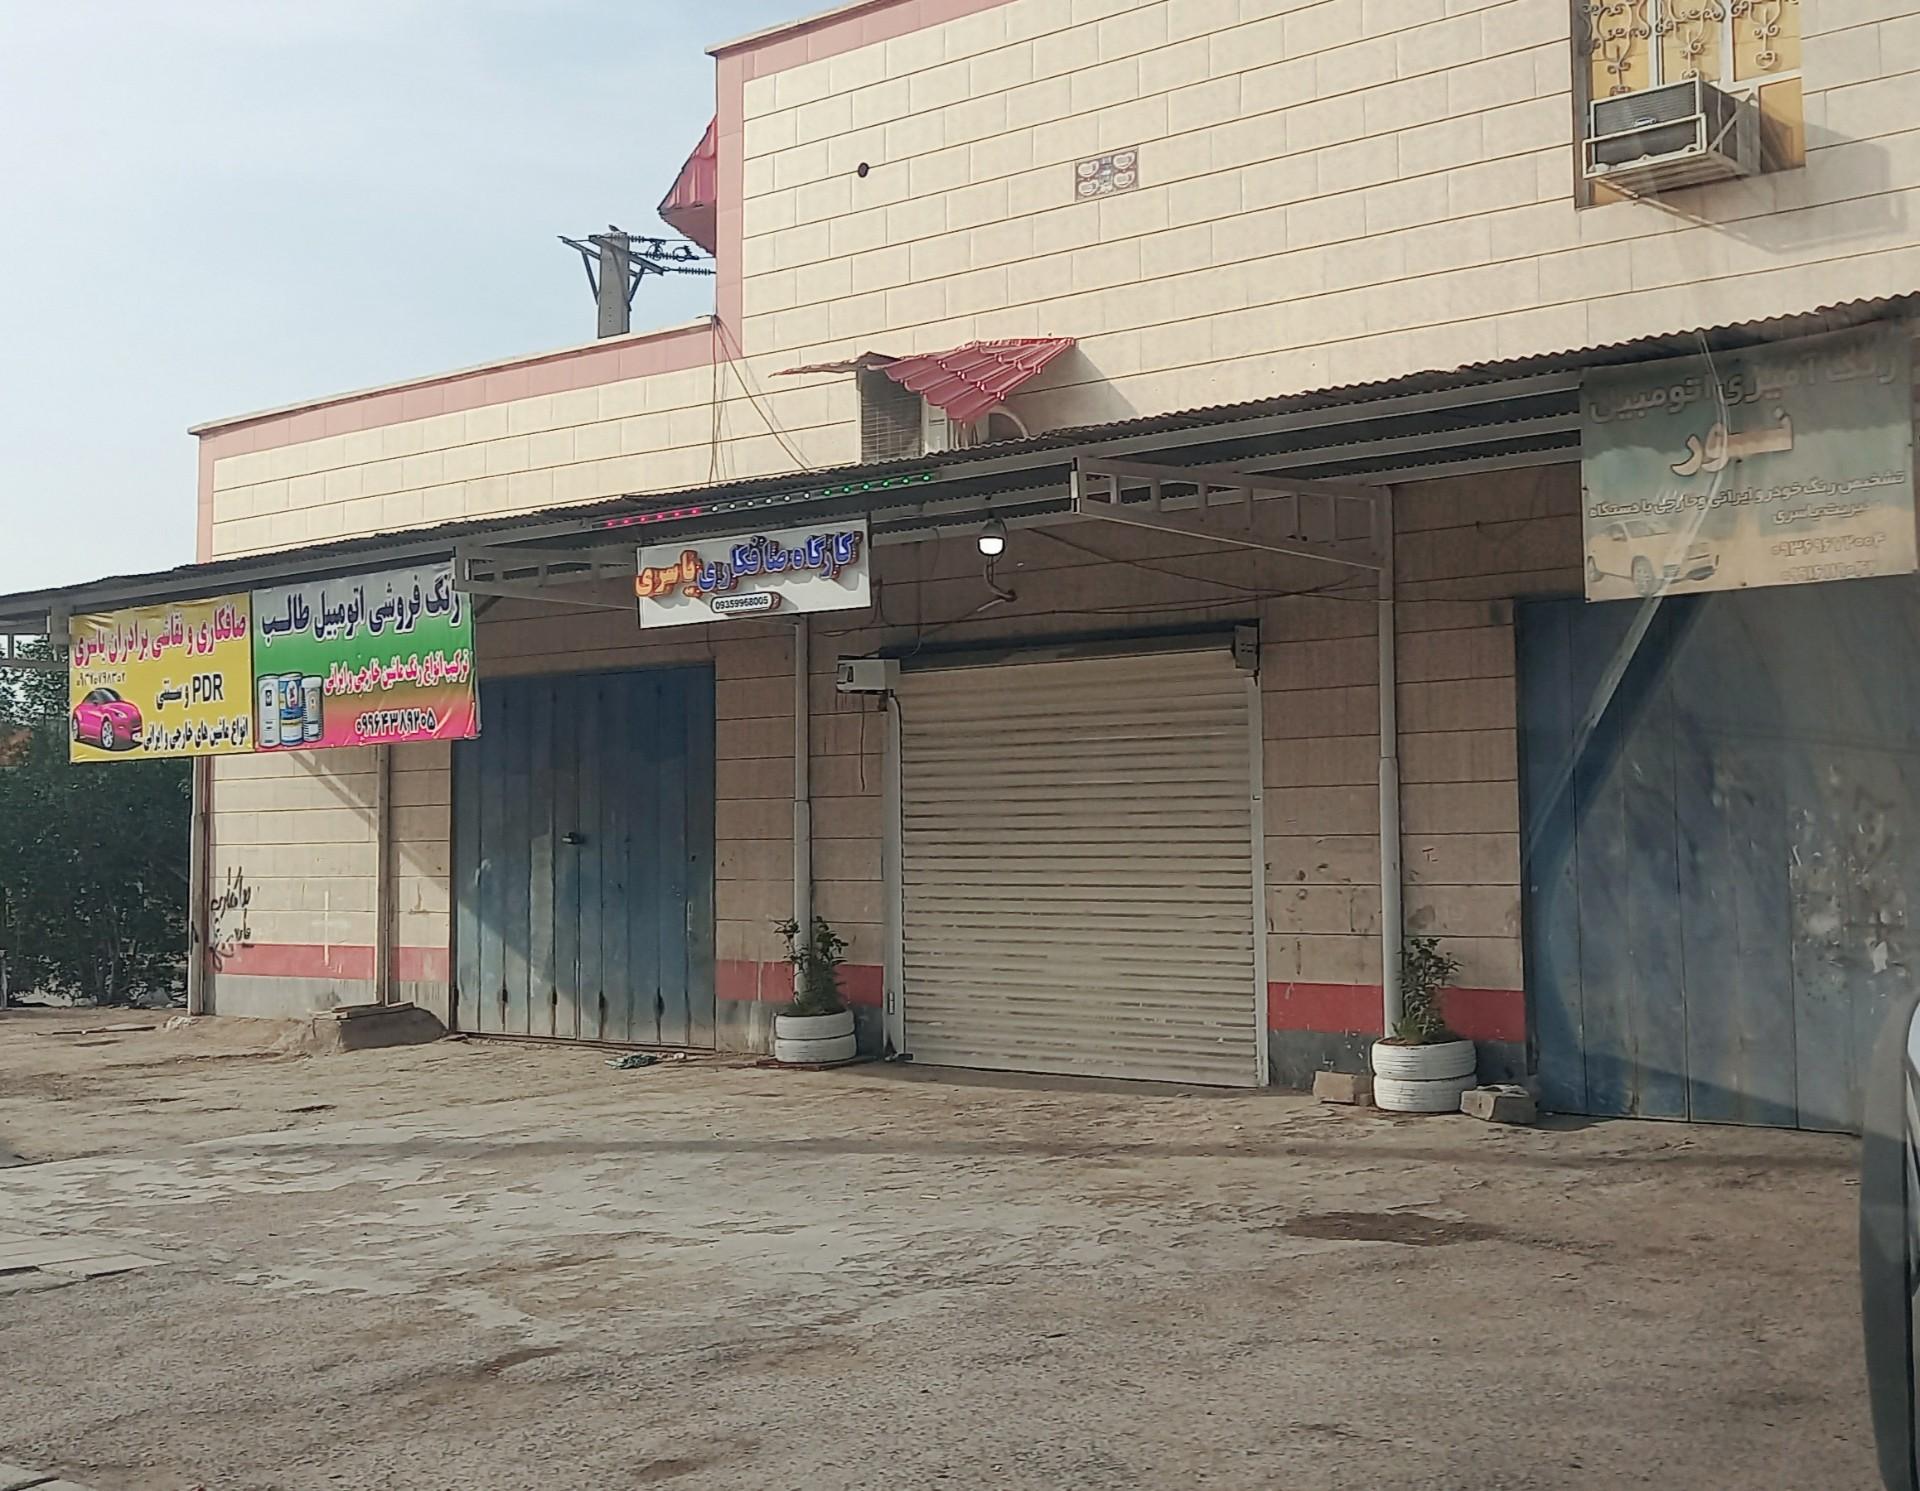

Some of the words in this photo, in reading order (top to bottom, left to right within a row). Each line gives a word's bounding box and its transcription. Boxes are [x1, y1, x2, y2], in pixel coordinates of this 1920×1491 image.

[1670, 407, 1794, 477] نور
[636, 550, 700, 598] یاسری
[697, 536, 789, 592] صافکاری
[791, 533, 857, 578] کارگاه
[196, 603, 247, 655] صافکاری
[314, 585, 365, 640] اتومبیل
[369, 574, 421, 634] فروشی
[109, 620, 149, 664] برادران
[150, 612, 185, 660] نقاشی
[192, 674, 224, 703] PDR
